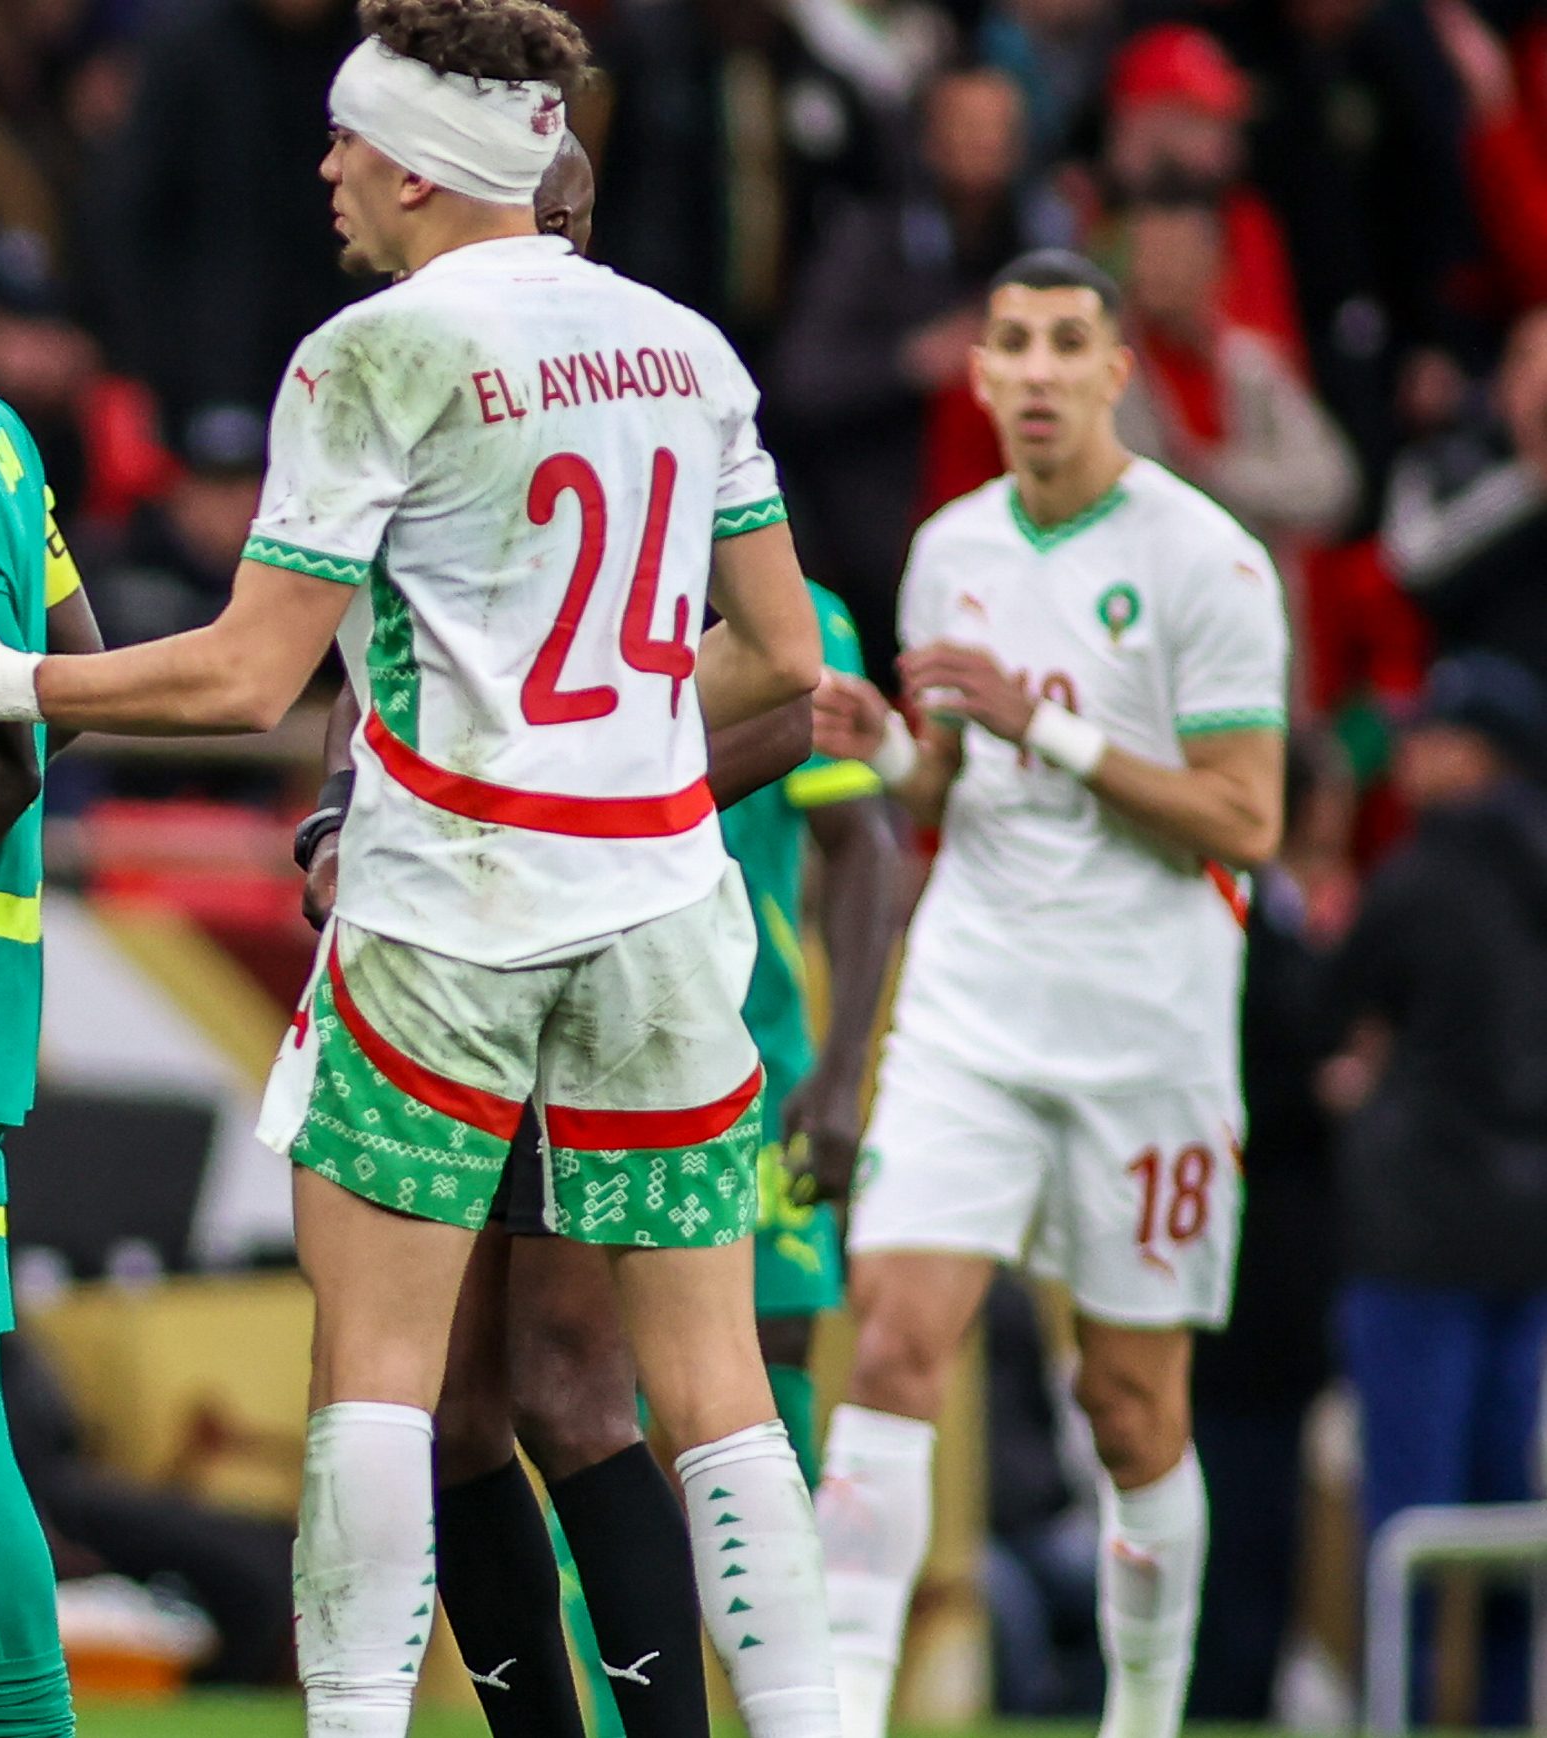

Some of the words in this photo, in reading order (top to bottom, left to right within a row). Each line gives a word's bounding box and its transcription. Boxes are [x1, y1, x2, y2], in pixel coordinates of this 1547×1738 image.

[472, 368, 528, 424] EL
[538, 347, 702, 411] AYNAOUI
[520, 446, 696, 727] 24
[1125, 1144, 1215, 1243] 18
